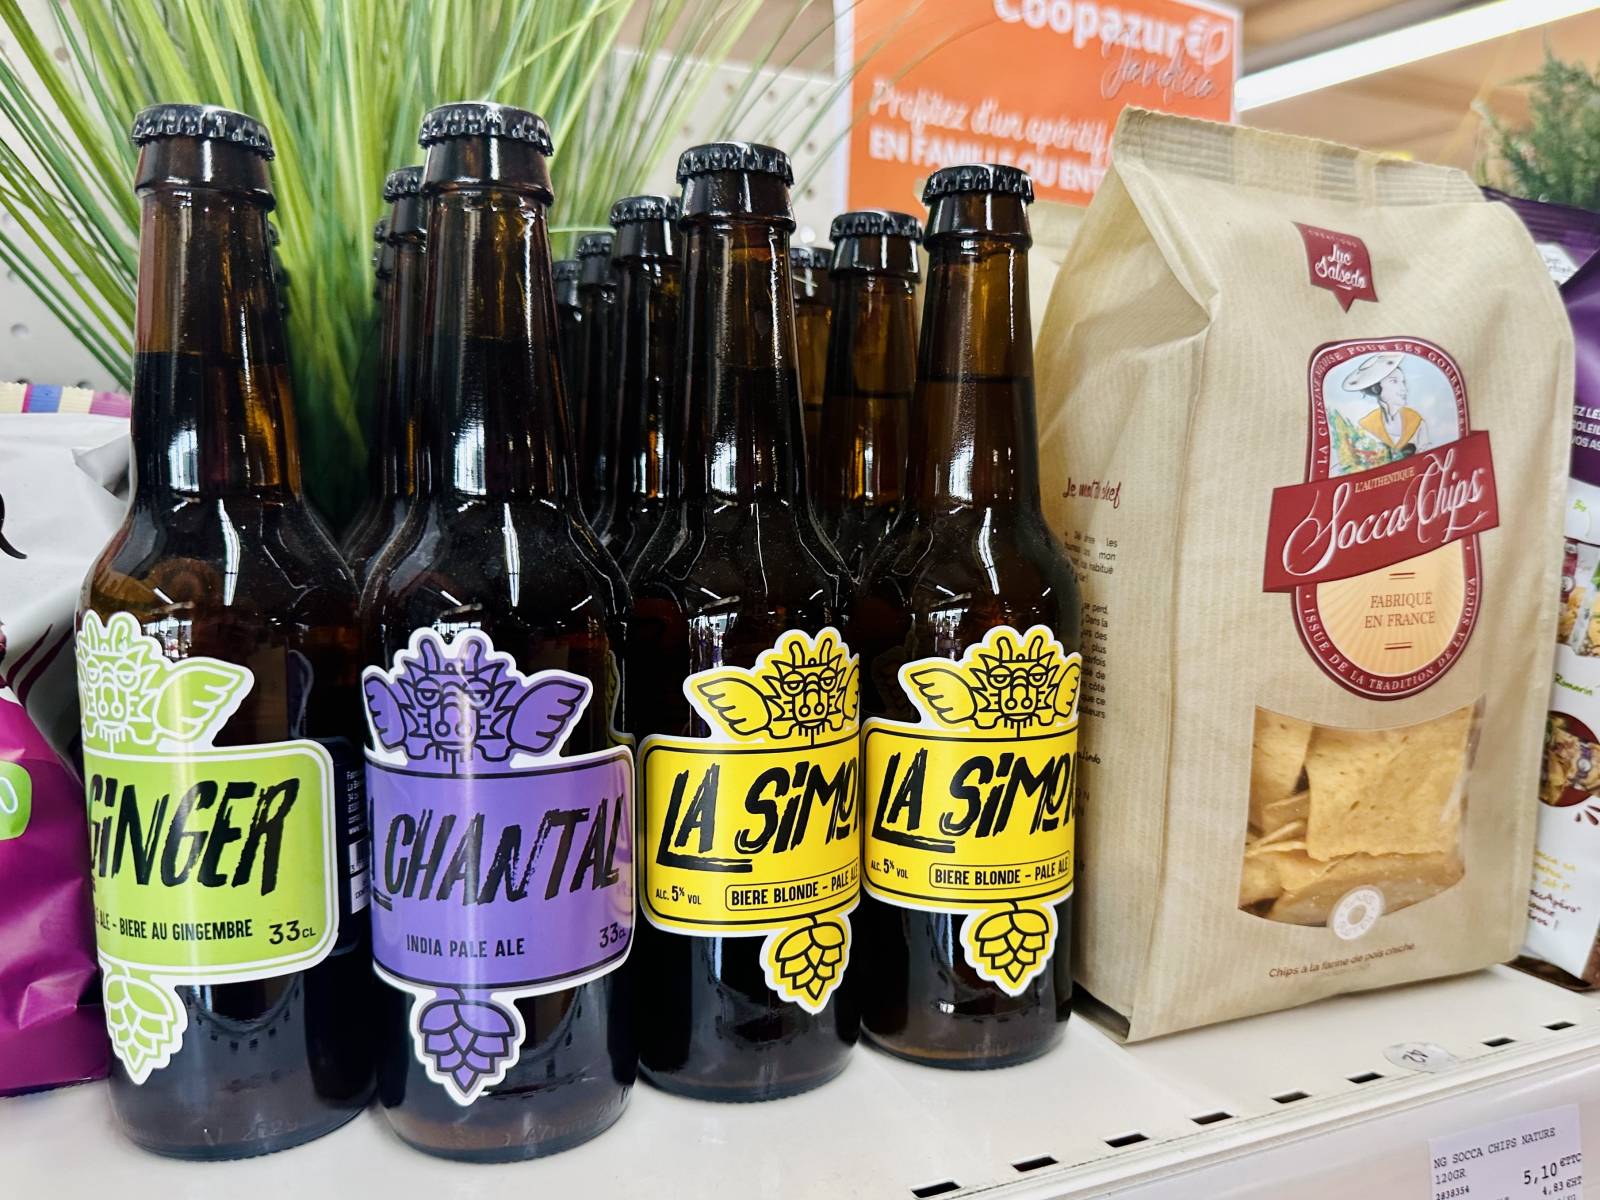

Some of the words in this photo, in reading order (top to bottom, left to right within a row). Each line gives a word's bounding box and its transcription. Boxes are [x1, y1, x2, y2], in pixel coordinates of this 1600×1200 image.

[869, 124, 909, 163] EN
[1315, 255, 1367, 288] Salsedo
[1395, 344, 1421, 353] LES
[1282, 483, 1410, 576] Socca
[1403, 449, 1488, 543] Chips
[1370, 592, 1432, 608] FABRIQUE
[1365, 615, 1382, 628] EN
[1387, 611, 1435, 627] FRANCE
[1304, 608, 1330, 652] ISSUE
[1328, 654, 1346, 672] DE
[1350, 670, 1364, 685] LA
[1369, 667, 1434, 690] TRADITION
[872, 747, 956, 853] LA
[656, 763, 753, 873] LA
[384, 793, 624, 906] CHANTAL
[896, 867, 909, 879] VOL
[935, 868, 970, 885] BIERE
[975, 868, 1021, 885] BLONDE
[1035, 862, 1056, 881] PALE
[1058, 856, 1069, 872] ALE
[687, 894, 702, 905] VOL
[731, 889, 769, 906] BIERE
[773, 882, 819, 904] BLONDE
[831, 872, 849, 892] PALE
[120, 917, 147, 939] BIERE
[152, 921, 168, 940] AU
[172, 919, 253, 941] GINGEMBRE
[406, 934, 442, 957] INDIA
[450, 939, 487, 958] PALE
[495, 938, 525, 957] ALE
[1269, 967, 1299, 978] Chips
[1309, 963, 1320, 973] la
[1433, 1156, 1447, 1168] NG
[1453, 1147, 1483, 1164] SOCCA
[1488, 1138, 1517, 1154] CHIPS
[1521, 1127, 1556, 1145] NATURE
[1434, 1168, 1466, 1185] 120GR
[1523, 1162, 1557, 1185] 5,10
[1542, 1181, 1564, 1196] 4,83
